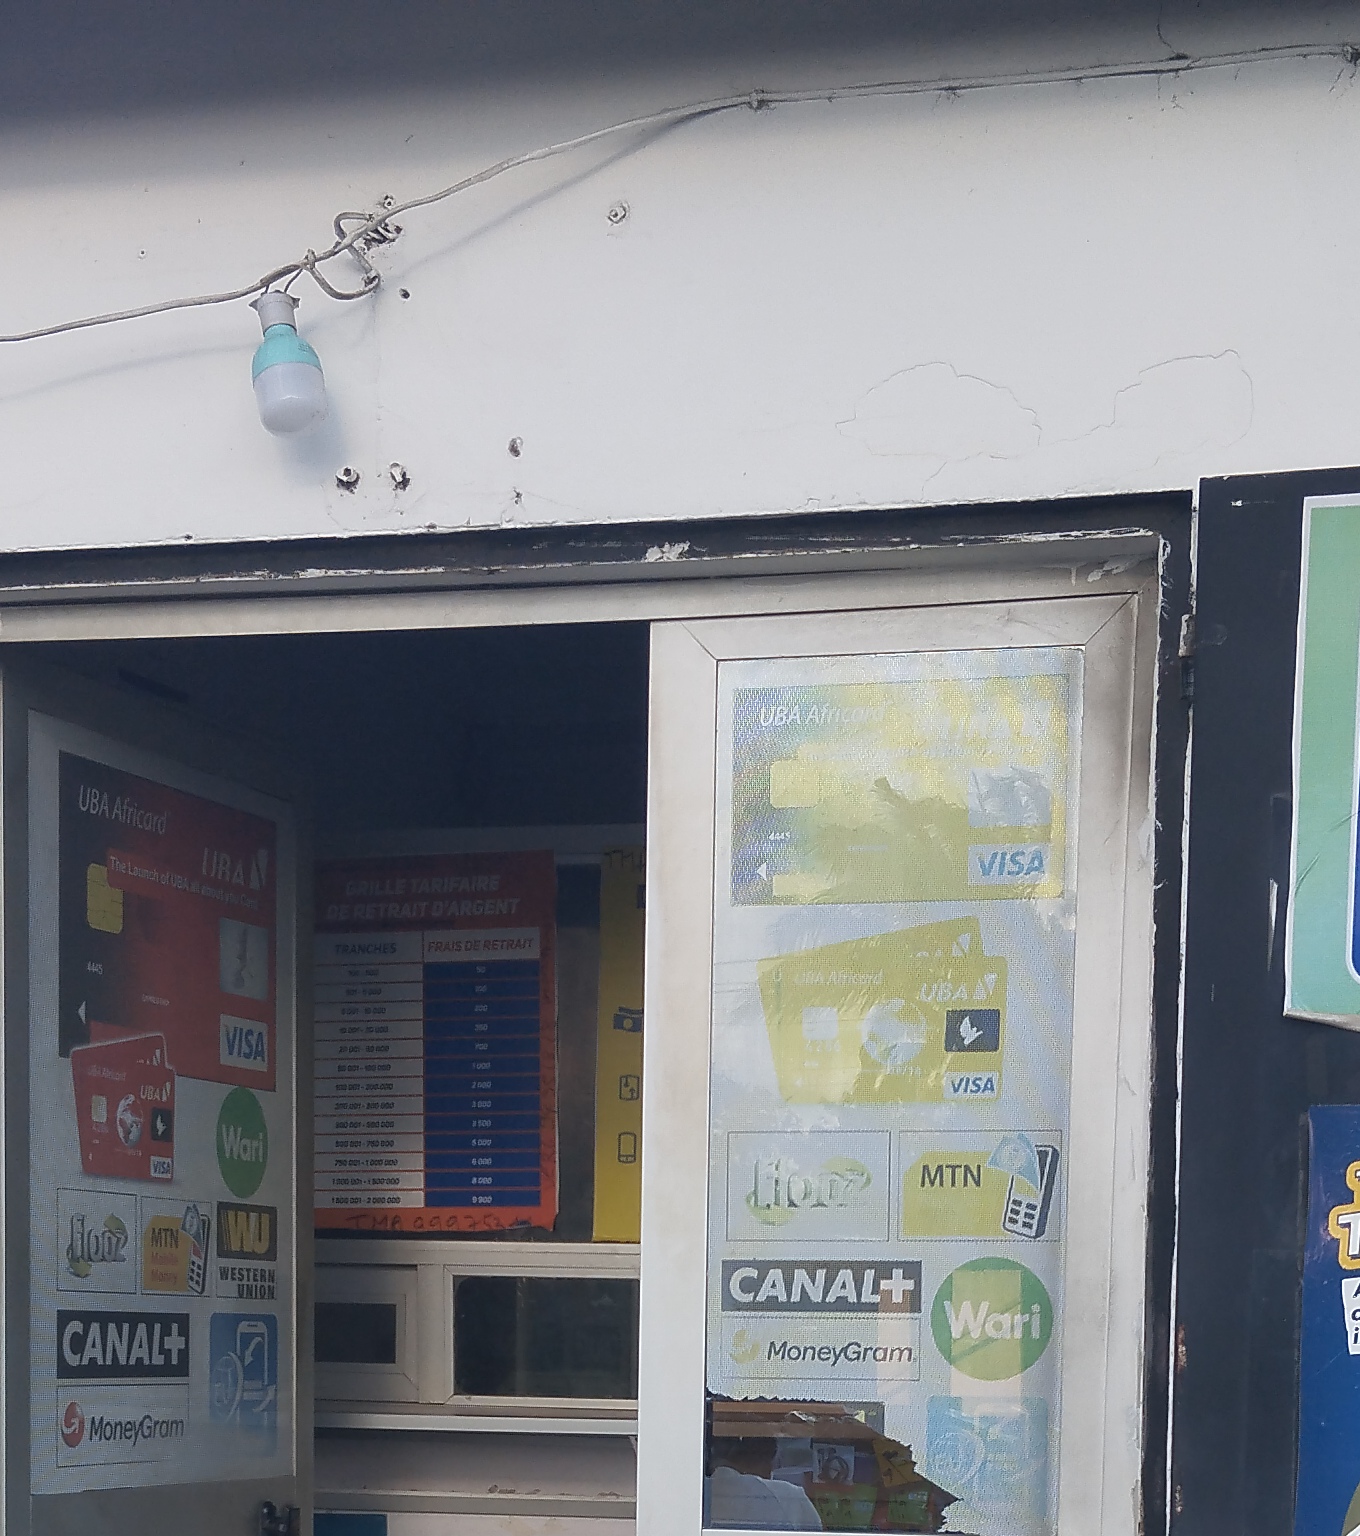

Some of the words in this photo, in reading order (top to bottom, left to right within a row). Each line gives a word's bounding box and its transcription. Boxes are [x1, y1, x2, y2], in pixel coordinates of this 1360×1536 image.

[758, 705, 802, 727] UBA
[79, 785, 110, 819] UBA
[111, 796, 168, 835] Africard
[977, 849, 1045, 877] VISA
[410, 874, 501, 895] TARIFAIRE
[353, 901, 428, 920] RETRAIT
[335, 942, 397, 955] TRANCHES
[427, 940, 462, 953] FRAIS
[482, 937, 535, 951] RETRAIT
[224, 1024, 266, 1063] VISA
[951, 1075, 996, 1095] VISA
[221, 1121, 264, 1163] Wari
[919, 1163, 982, 1190] MTN
[150, 1226, 180, 1250] MTN
[218, 1266, 276, 1286] WESTERN
[728, 1266, 916, 1305] CANAL+
[237, 1283, 276, 1301] UNION
[943, 1299, 1041, 1341] Wari
[61, 1319, 186, 1368] CANAL+
[766, 1339, 914, 1368] MoneyGram
[88, 1413, 185, 1446] MoneyGram
